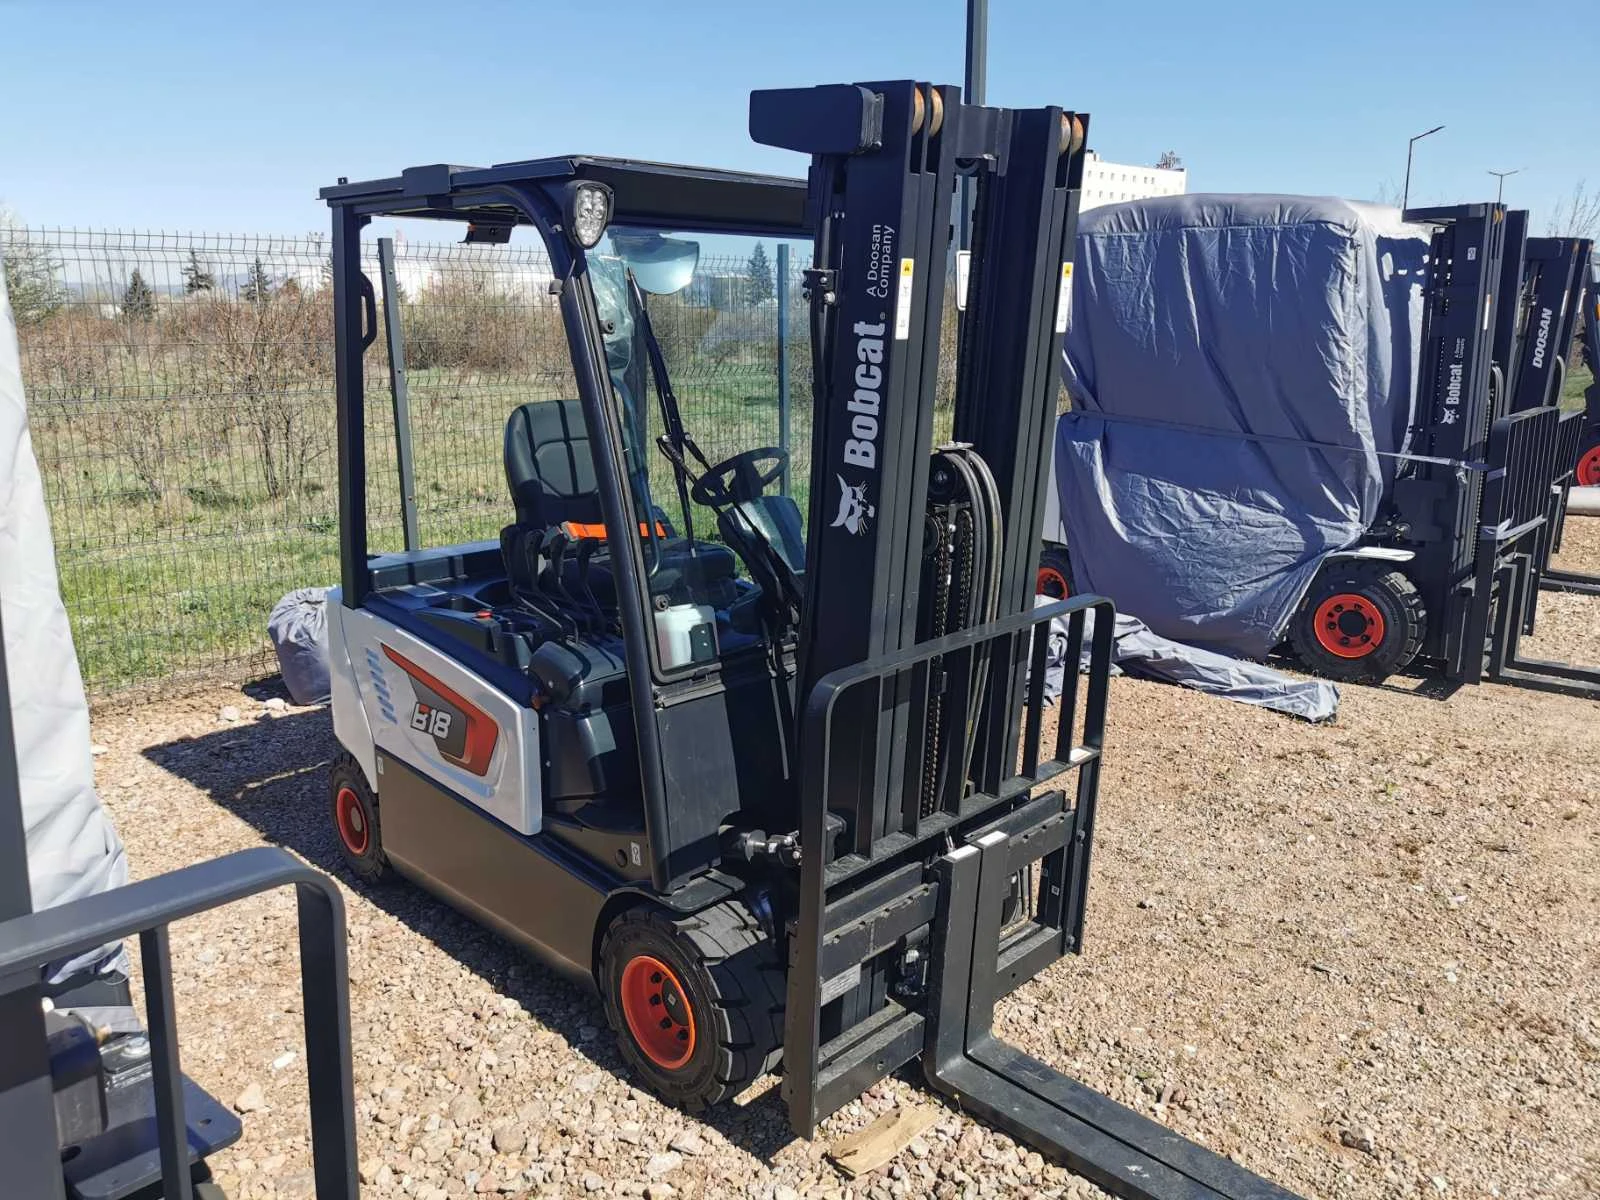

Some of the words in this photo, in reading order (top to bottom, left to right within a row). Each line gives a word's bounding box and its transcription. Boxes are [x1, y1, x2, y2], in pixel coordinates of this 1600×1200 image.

[867, 224, 882, 281] Doosan
[877, 225, 895, 298] Company
[866, 286, 877, 297] A
[1532, 307, 1553, 369] DOOSAN
[844, 320, 886, 469] Bobcat
[1446, 364, 1463, 405] Bobcat
